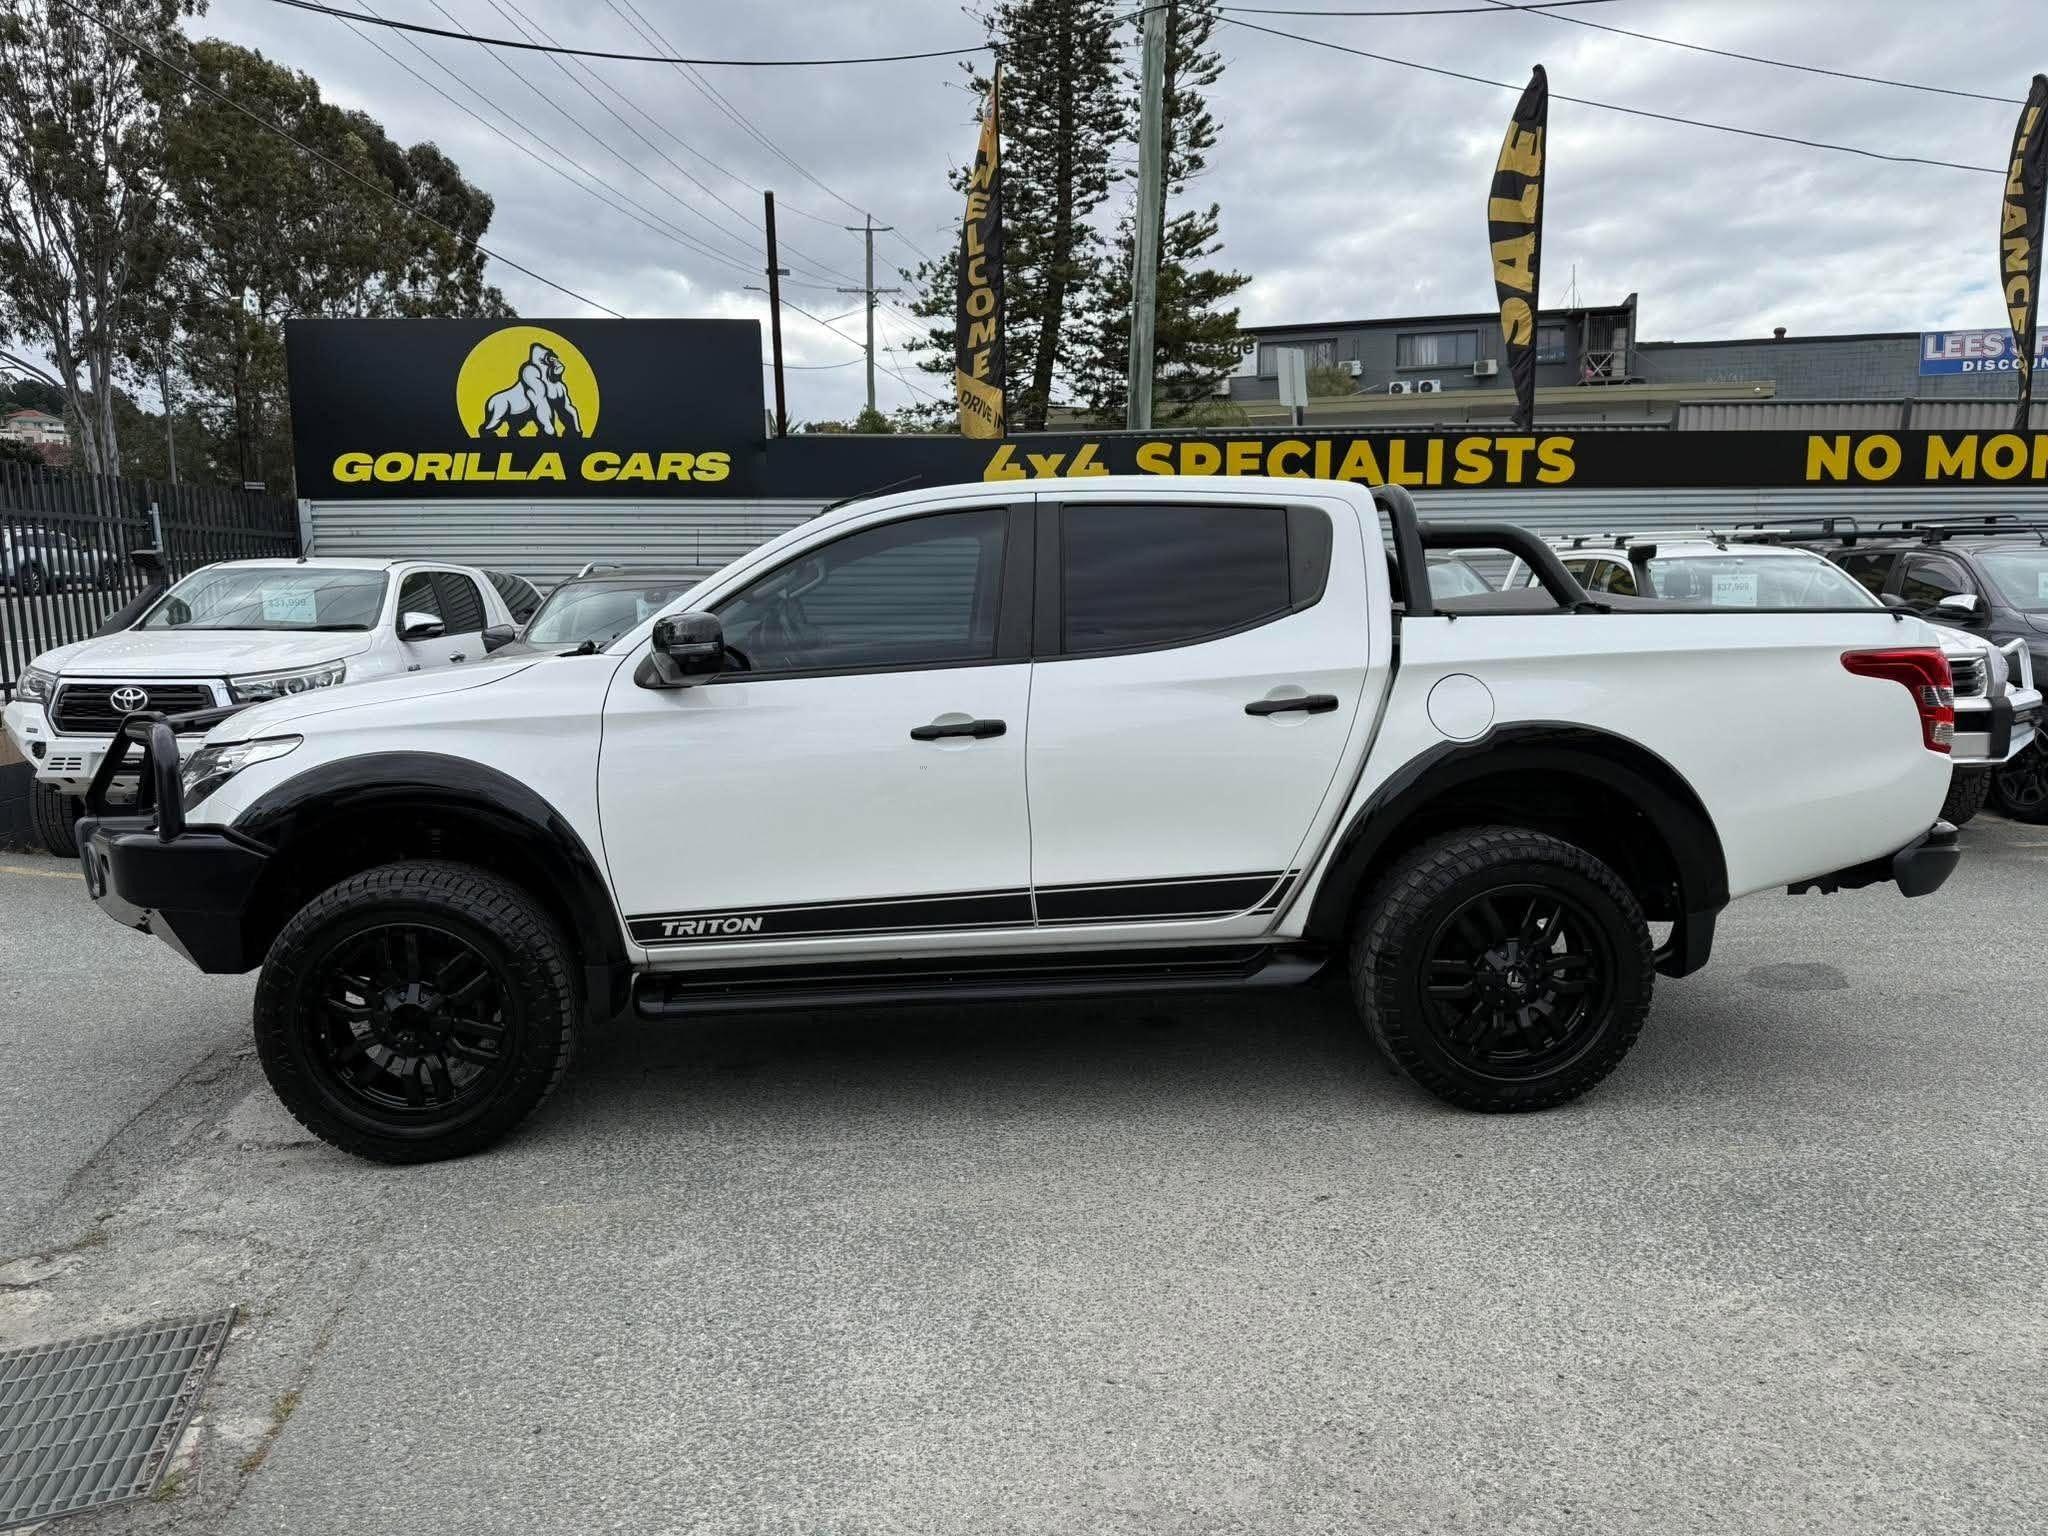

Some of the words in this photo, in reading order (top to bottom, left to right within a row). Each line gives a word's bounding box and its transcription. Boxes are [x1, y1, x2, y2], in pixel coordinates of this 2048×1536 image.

[960, 390, 992, 424] DRIVE
[332, 452, 567, 482] GORILLA
[581, 452, 731, 482] CARS
[984, 443, 1110, 481] 4x4
[1136, 437, 1576, 486] SPECIALISTS
[1806, 434, 1902, 481] NO
[662, 917, 764, 936] TRITON
